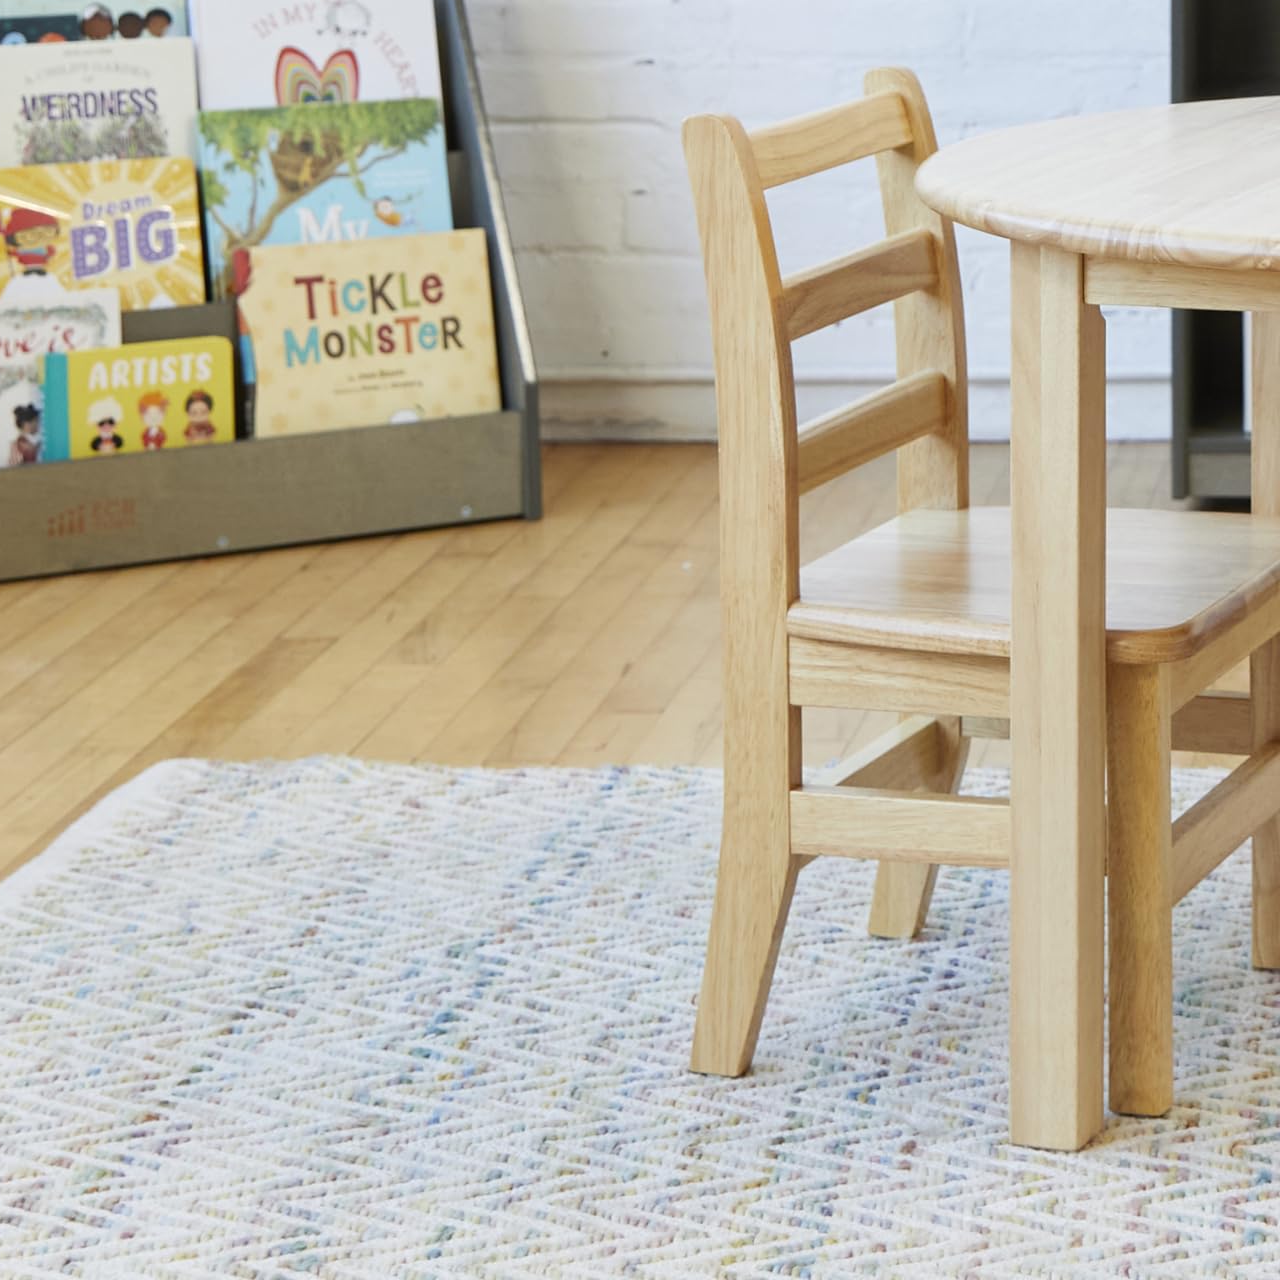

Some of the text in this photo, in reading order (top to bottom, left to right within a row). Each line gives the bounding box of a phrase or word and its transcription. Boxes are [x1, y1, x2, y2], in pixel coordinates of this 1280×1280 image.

[253, 13, 277, 38] IN
[284, 2, 316, 28] MY
[83, 195, 152, 219] Dream
[71, 209, 176, 279] BIG
[88, 353, 213, 392] ARTISTS
